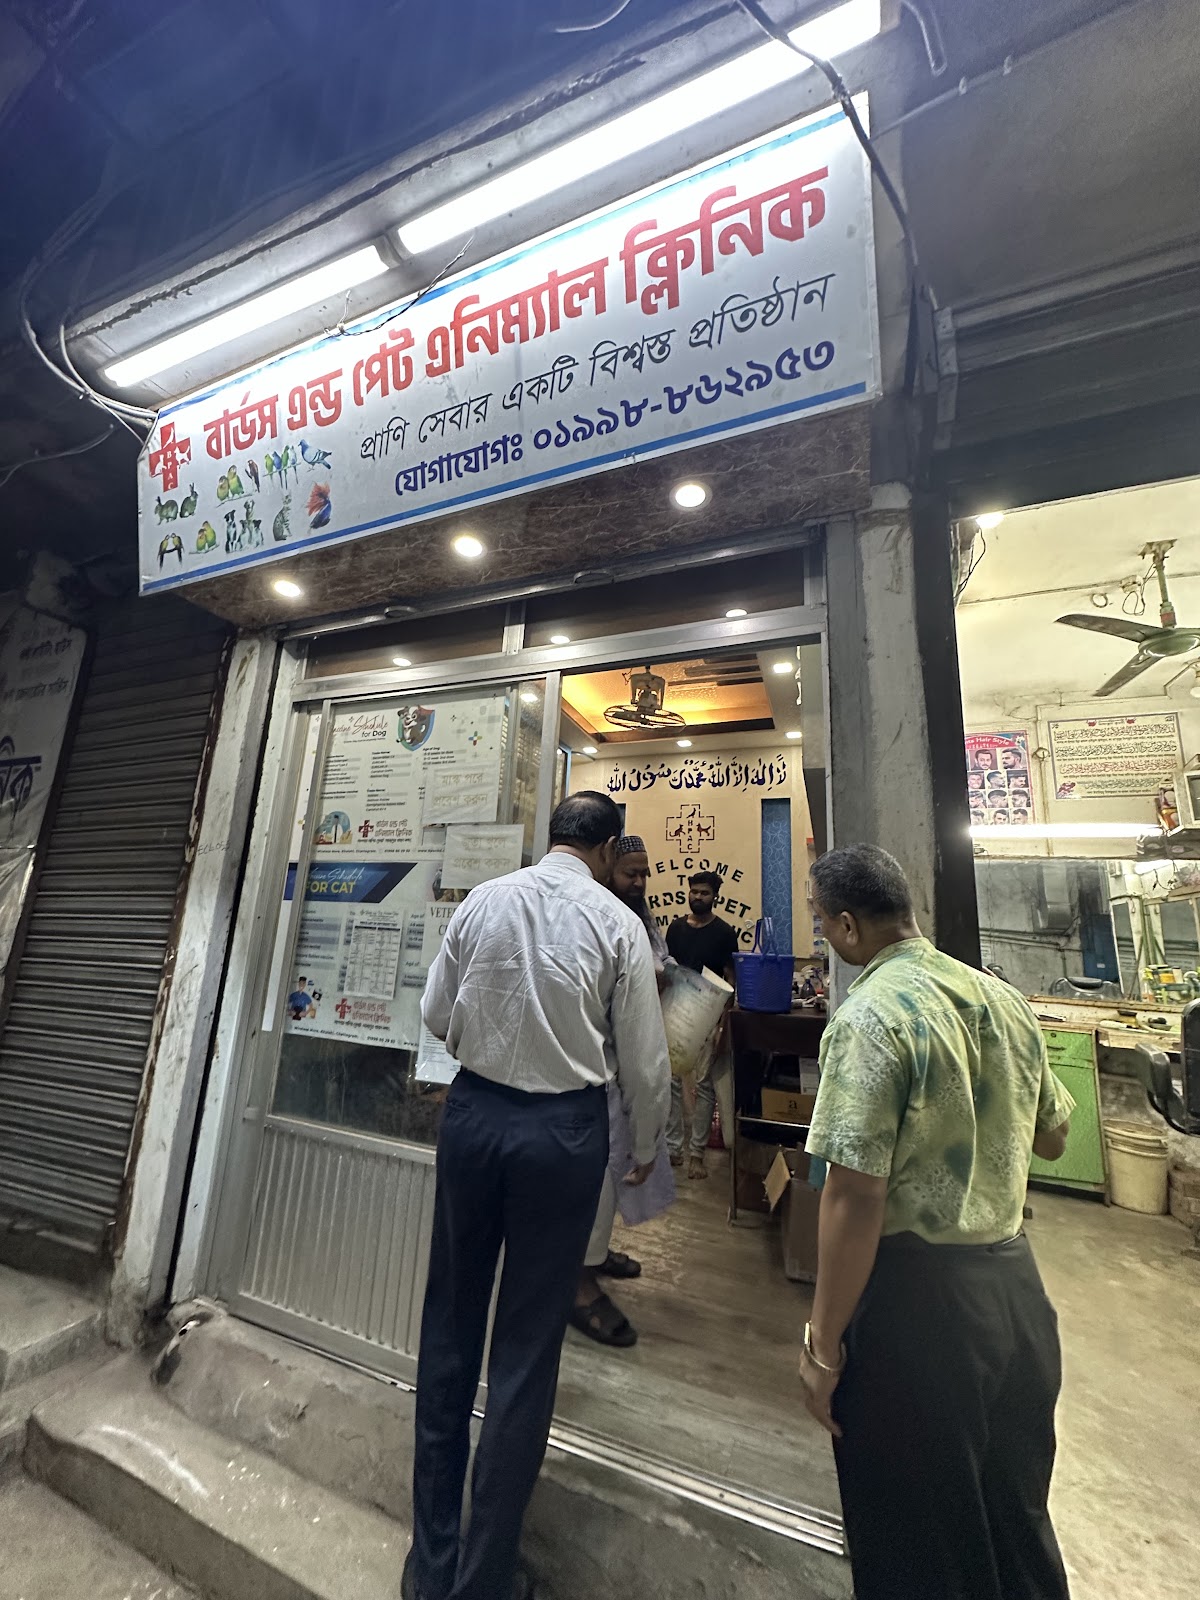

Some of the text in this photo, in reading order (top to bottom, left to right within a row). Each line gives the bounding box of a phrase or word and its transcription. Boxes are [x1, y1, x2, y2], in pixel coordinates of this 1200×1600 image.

[203, 166, 829, 460] বার্ডস এন্ড পেট এনিম্যাল ক্লিনিক
[360, 273, 836, 461] প্রাণি সেবার একটি বিশ্বস্ত প্রতিষ্ঠান
[533, 340, 835, 450] ০১৯৯৮-৮৬২৯৫৩
[330, 881, 356, 894] CAT
[648, 890, 686, 909] RDS
